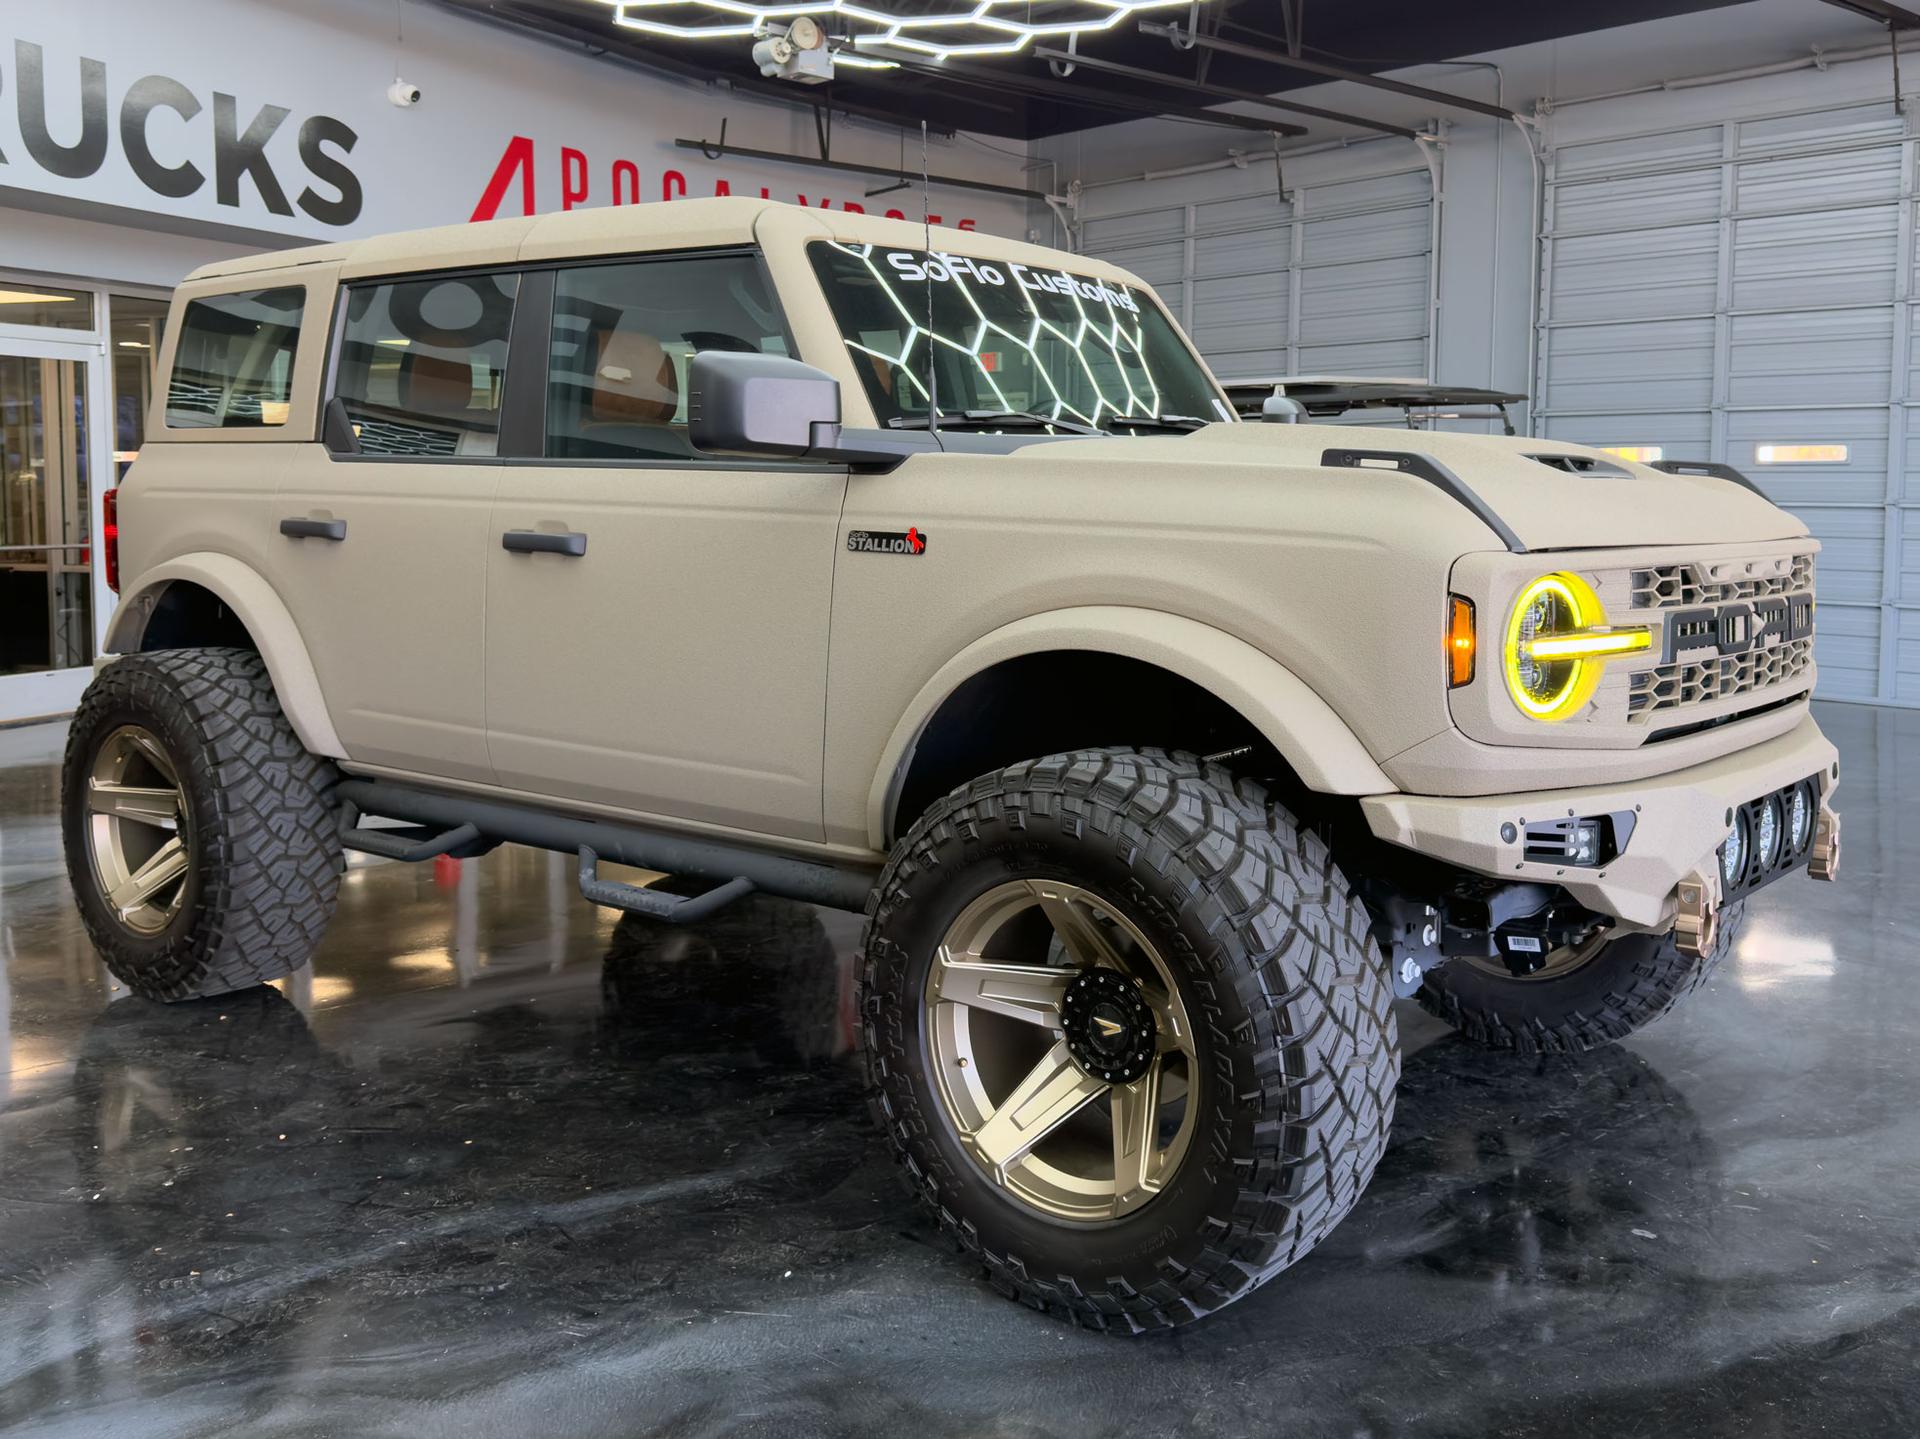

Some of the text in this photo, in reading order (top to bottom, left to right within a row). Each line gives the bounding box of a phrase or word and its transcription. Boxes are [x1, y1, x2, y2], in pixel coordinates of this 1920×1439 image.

[0, 38, 363, 226] UCKS
[886, 252, 1140, 313] SoFlo Customs
[848, 537, 915, 553] STALLION
[1660, 592, 1813, 664] FORD
